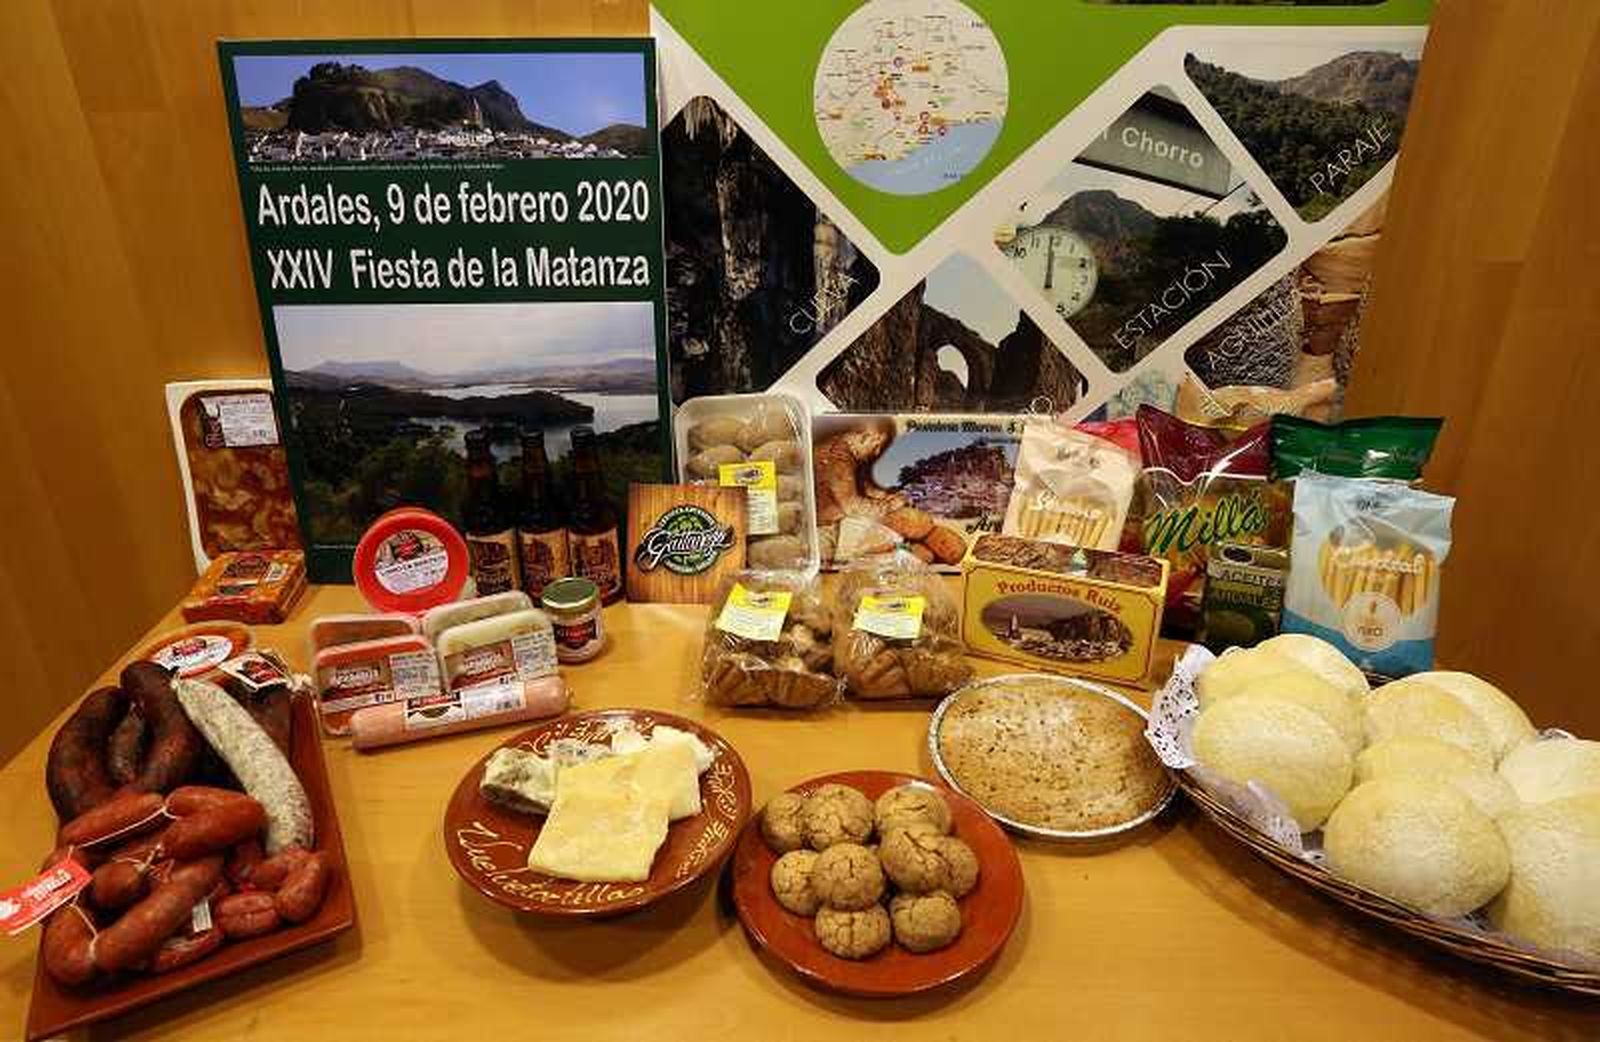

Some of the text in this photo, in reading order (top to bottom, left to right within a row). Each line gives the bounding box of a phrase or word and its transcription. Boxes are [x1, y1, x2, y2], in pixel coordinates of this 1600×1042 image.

[1121, 126, 1205, 169] Chorro
[1309, 120, 1392, 194] PARAJE
[258, 180, 650, 232] Ardales, 9 de febrero 2020
[267, 247, 652, 289] XXIV Fiesta de la Matanza
[1113, 249, 1233, 349] ESTACIÓN
[997, 580, 1121, 613] Productos Ruiz
